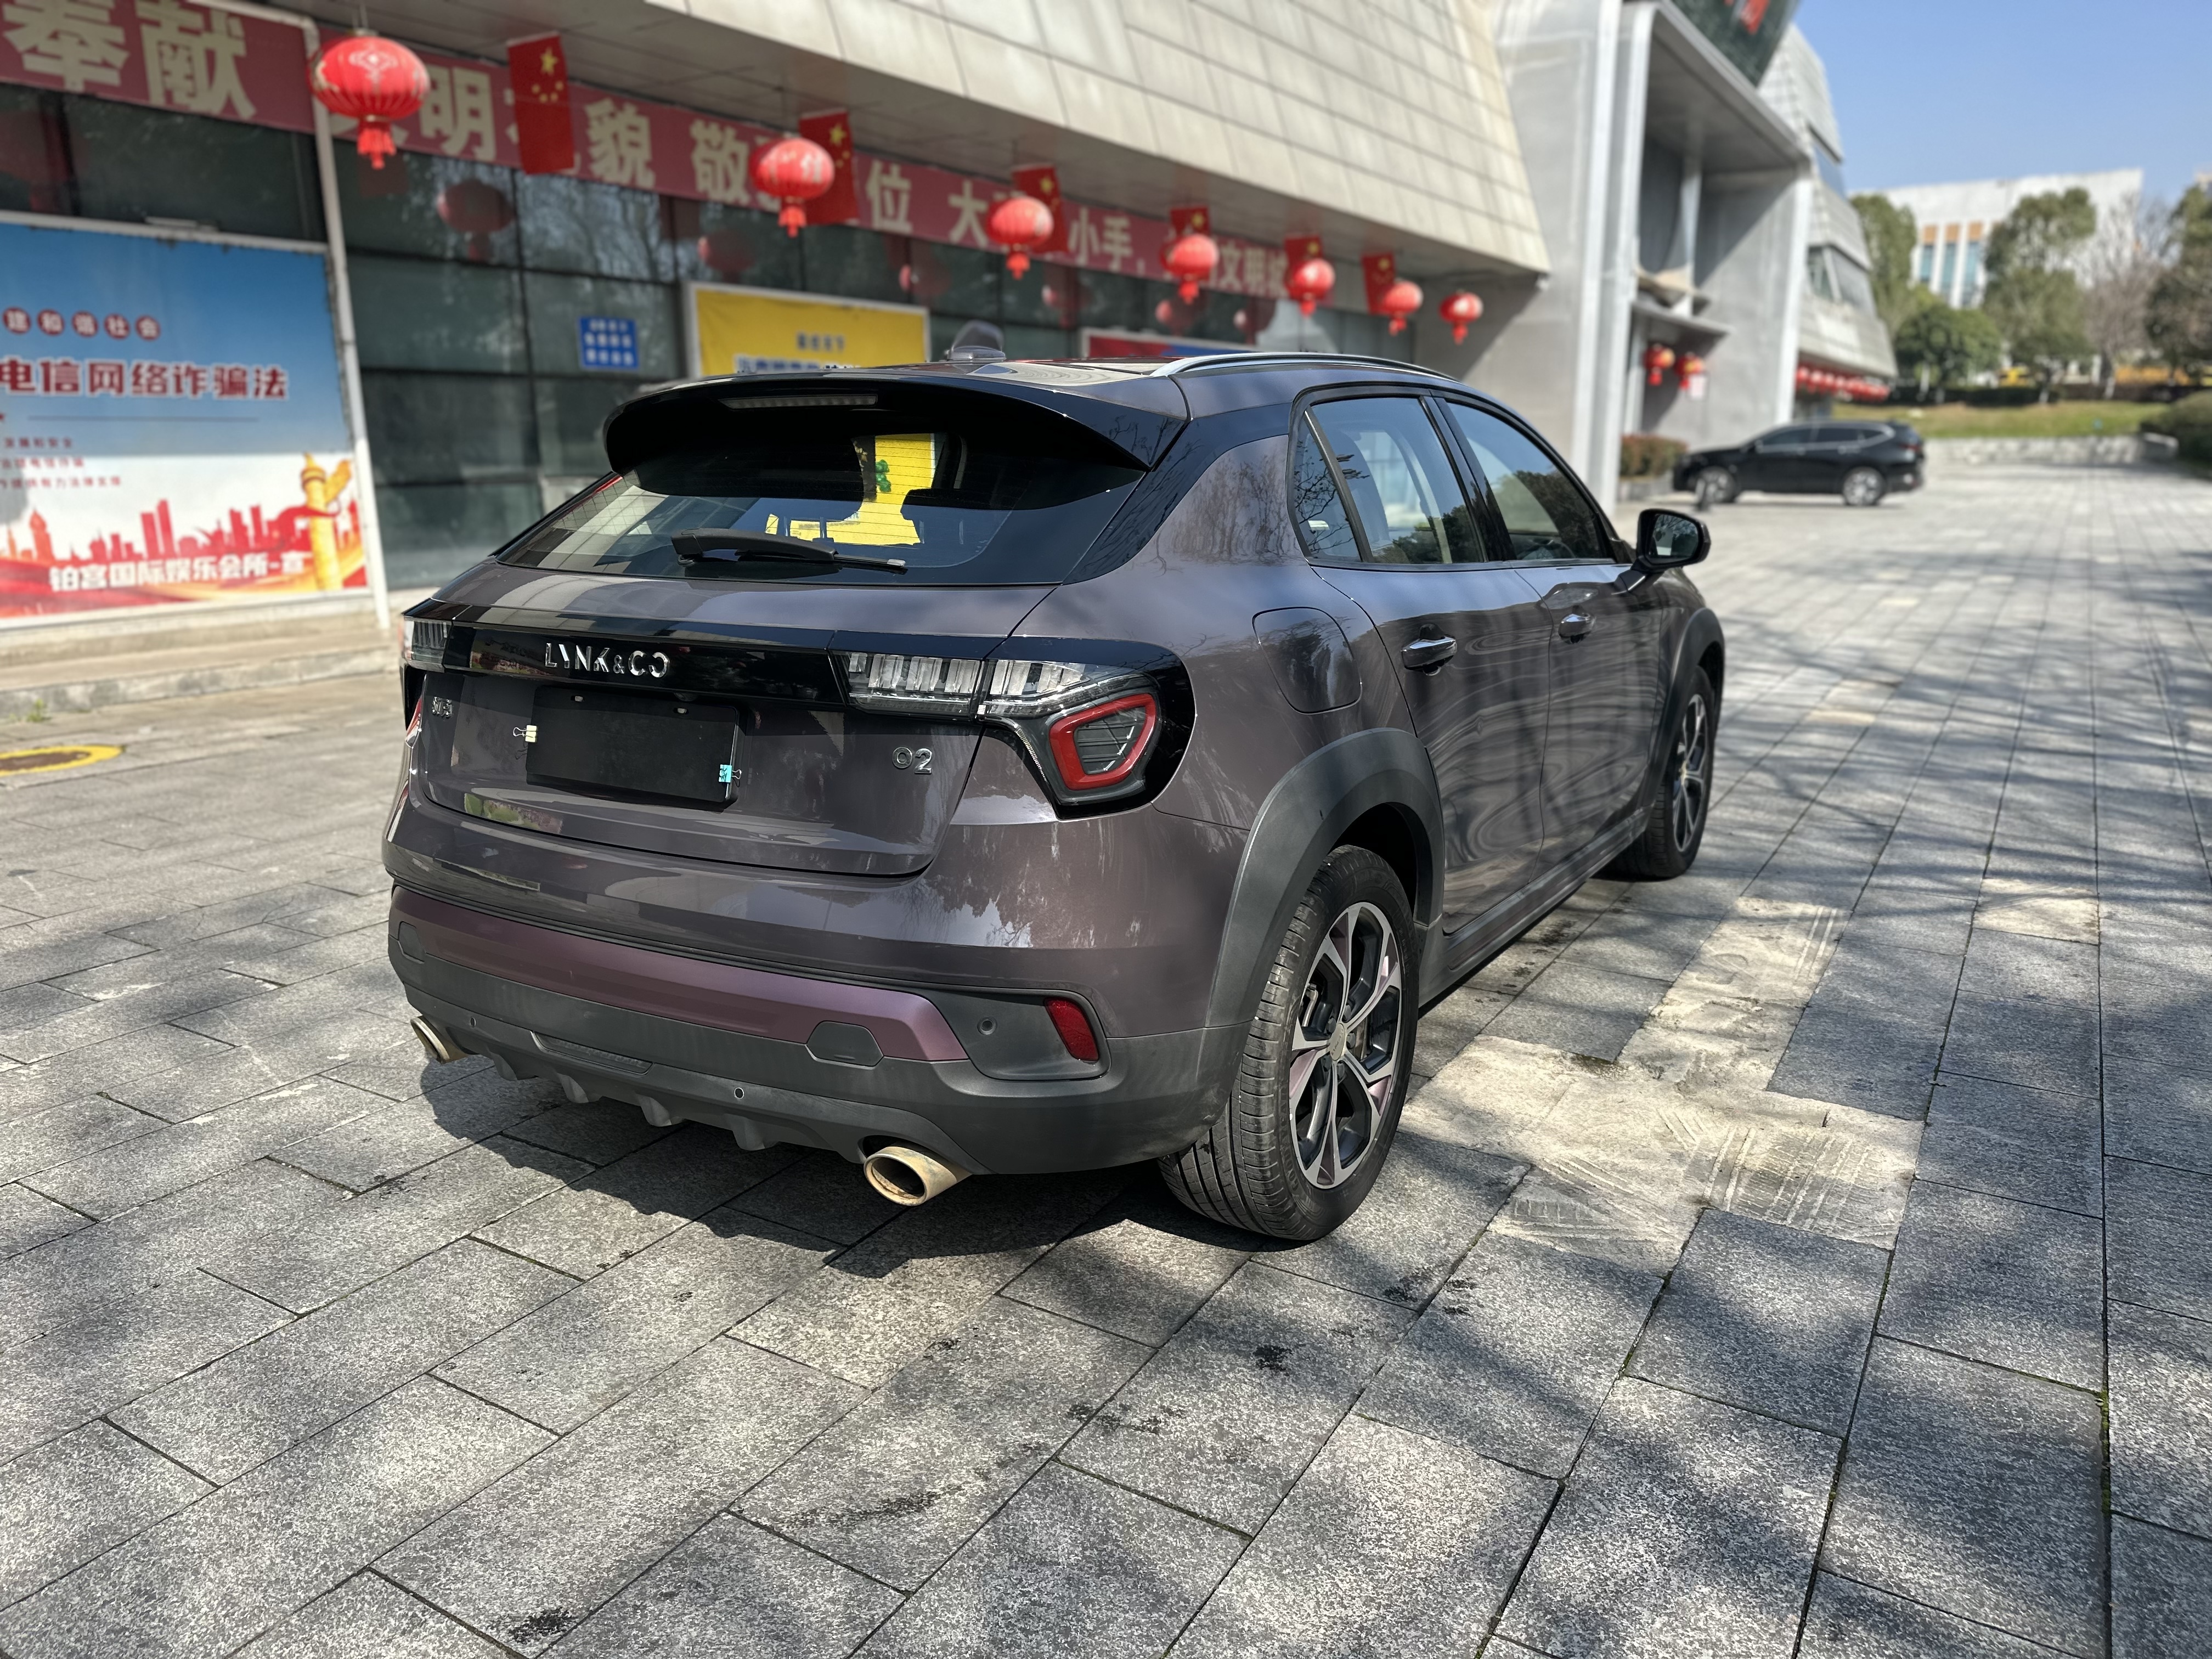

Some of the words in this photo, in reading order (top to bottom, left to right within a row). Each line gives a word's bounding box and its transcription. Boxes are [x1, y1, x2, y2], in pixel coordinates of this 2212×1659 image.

[2, 0, 257, 120] 奉献
[330, 61, 656, 190] 明貌
[690, 119, 913, 233] 敬位
[0, 356, 289, 400] 电信网络诈骗法
